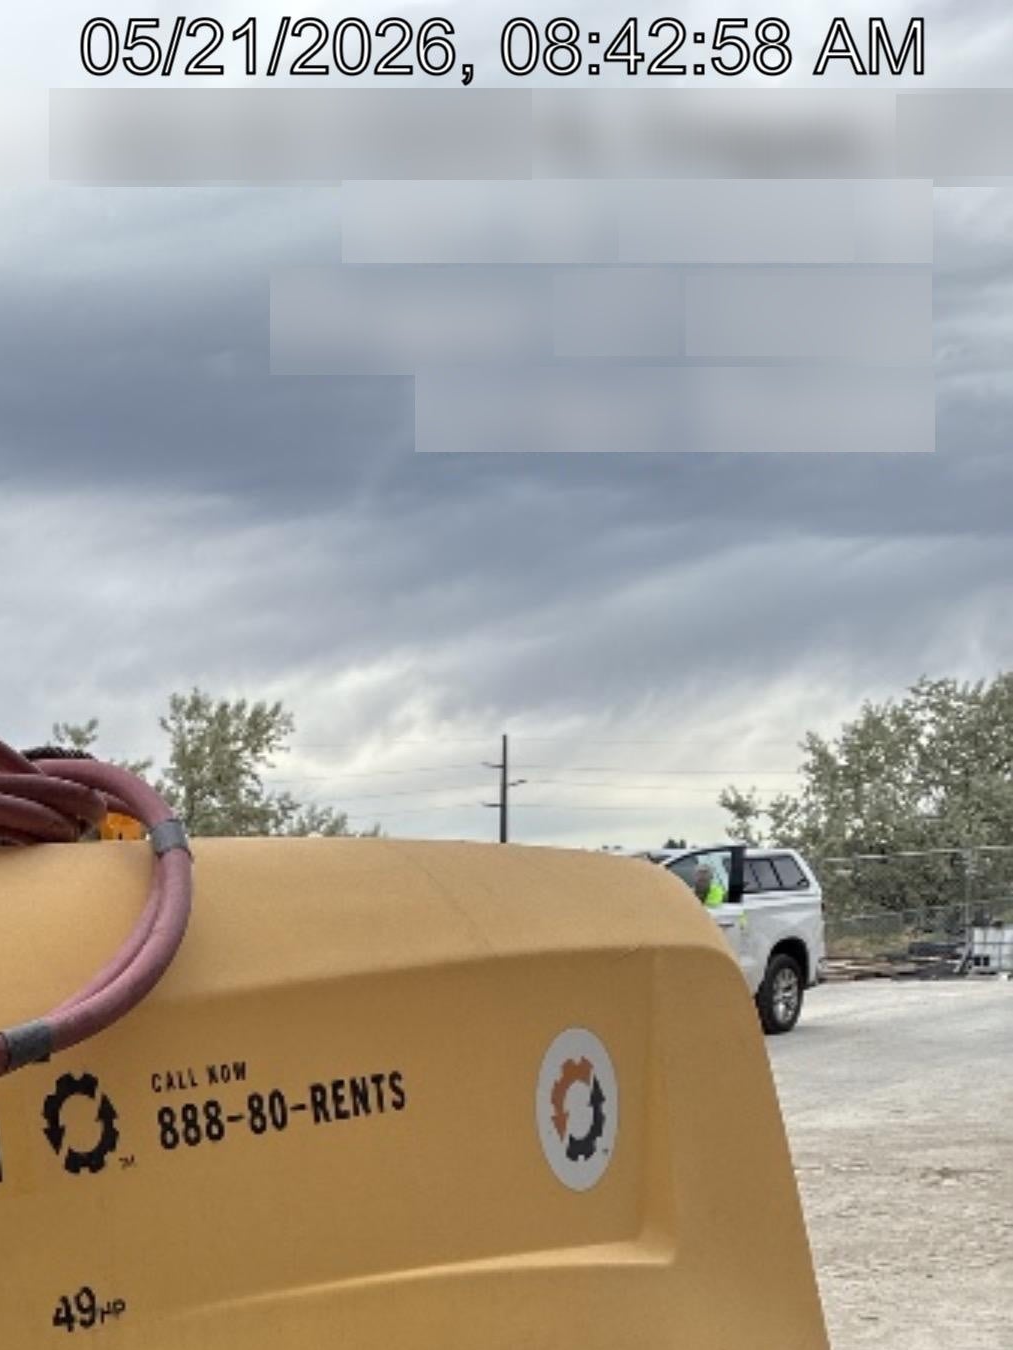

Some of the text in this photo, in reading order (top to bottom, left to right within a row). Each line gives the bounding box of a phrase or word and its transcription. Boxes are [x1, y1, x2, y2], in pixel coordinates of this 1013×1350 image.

[152, 1061, 247, 1093] CALL NOW
[157, 1070, 407, 1151] 888-80-RENTS
